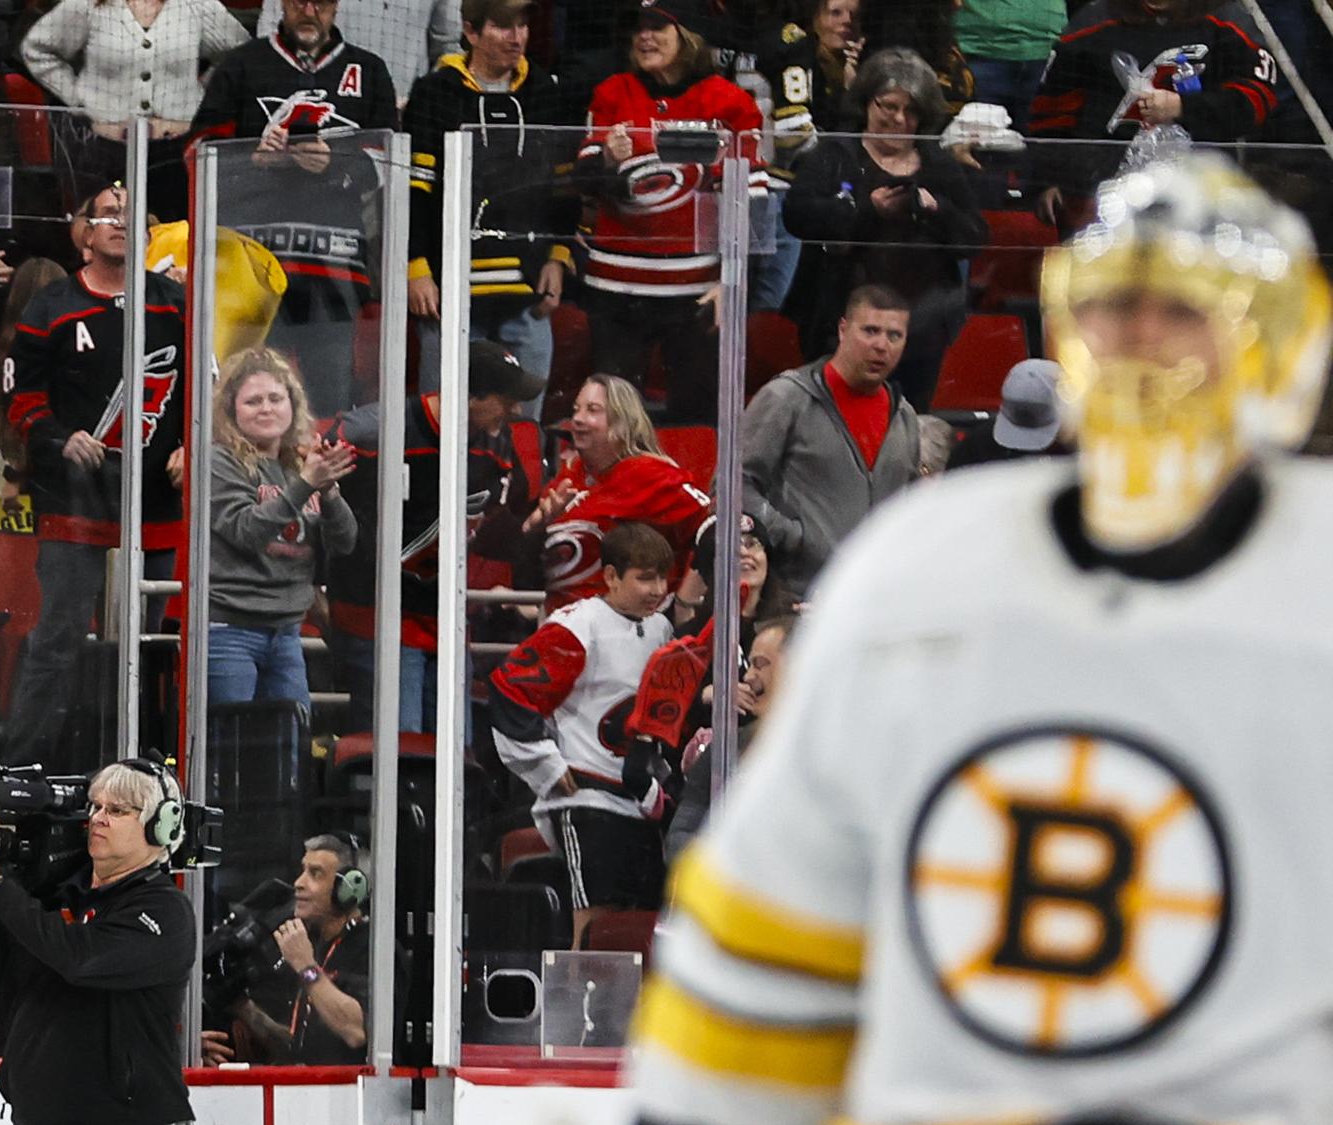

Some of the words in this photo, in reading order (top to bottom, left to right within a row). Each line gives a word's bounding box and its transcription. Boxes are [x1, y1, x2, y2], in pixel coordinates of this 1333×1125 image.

[338, 63, 363, 97] A
[76, 321, 95, 352] A
[989, 800, 1143, 978] B
